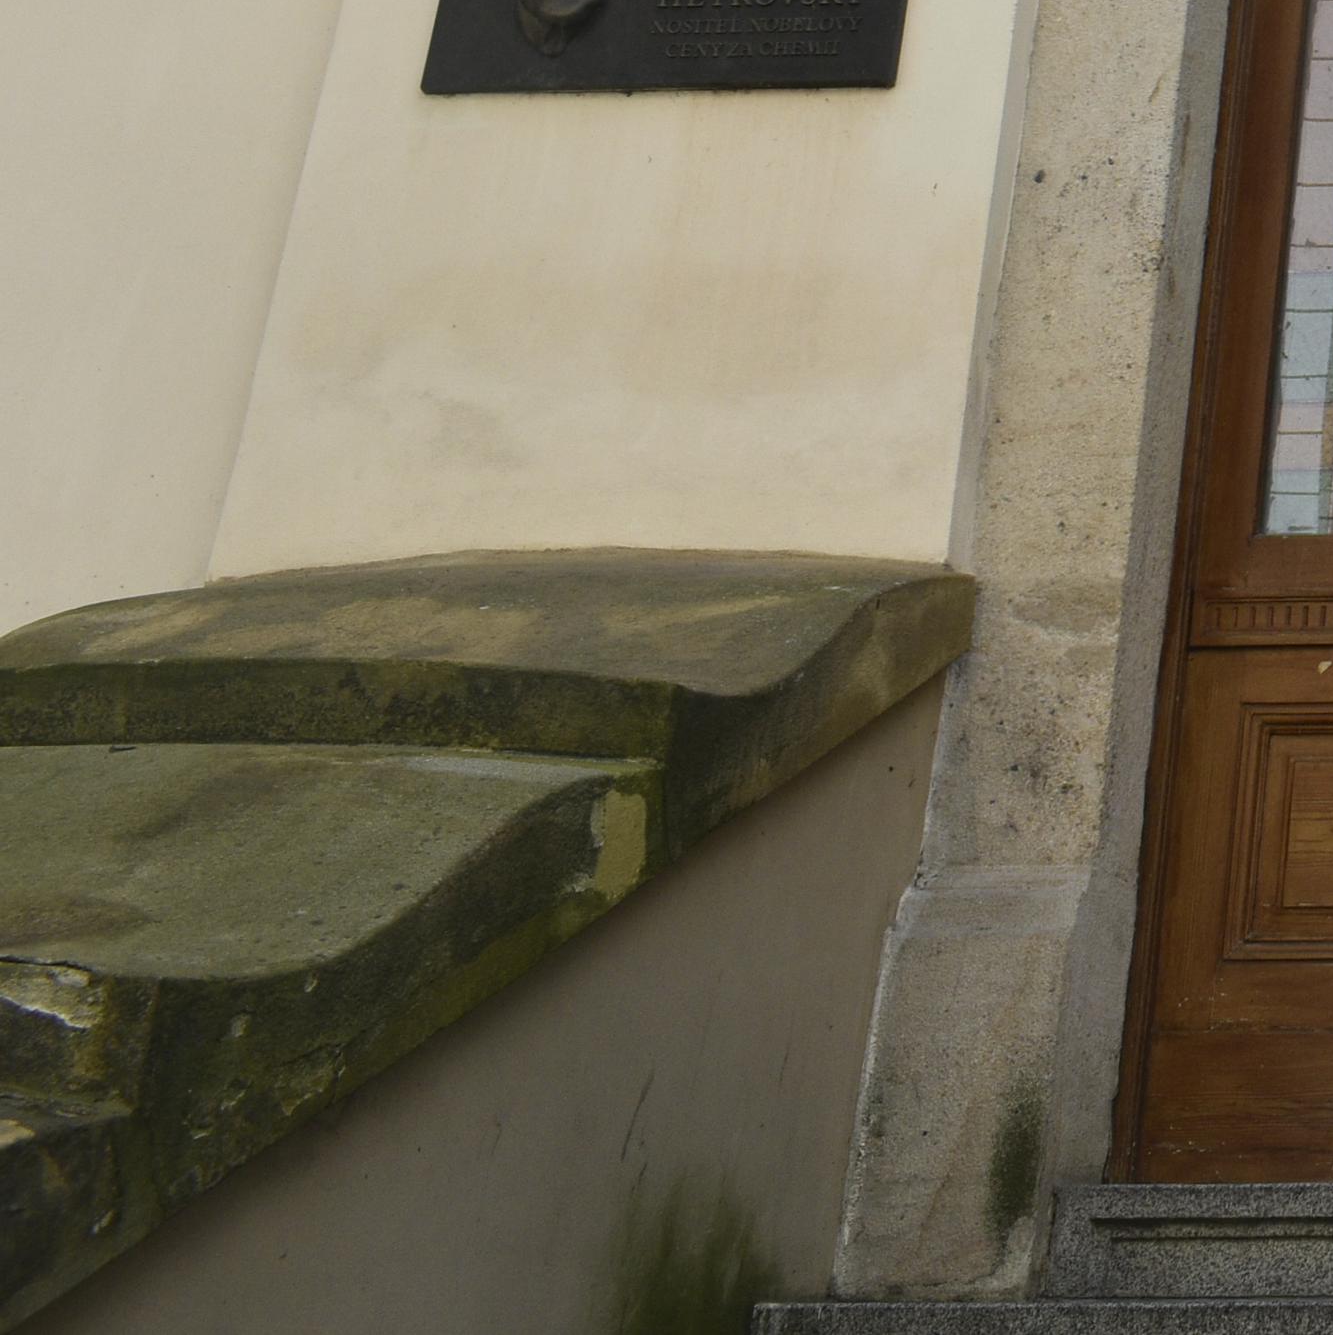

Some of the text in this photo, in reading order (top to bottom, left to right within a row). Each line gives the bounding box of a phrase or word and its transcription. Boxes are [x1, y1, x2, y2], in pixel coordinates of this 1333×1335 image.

[648, 16, 864, 37] NOSITEL NOBELOVY
[664, 39, 842, 59] CENY ZA CHEMII
